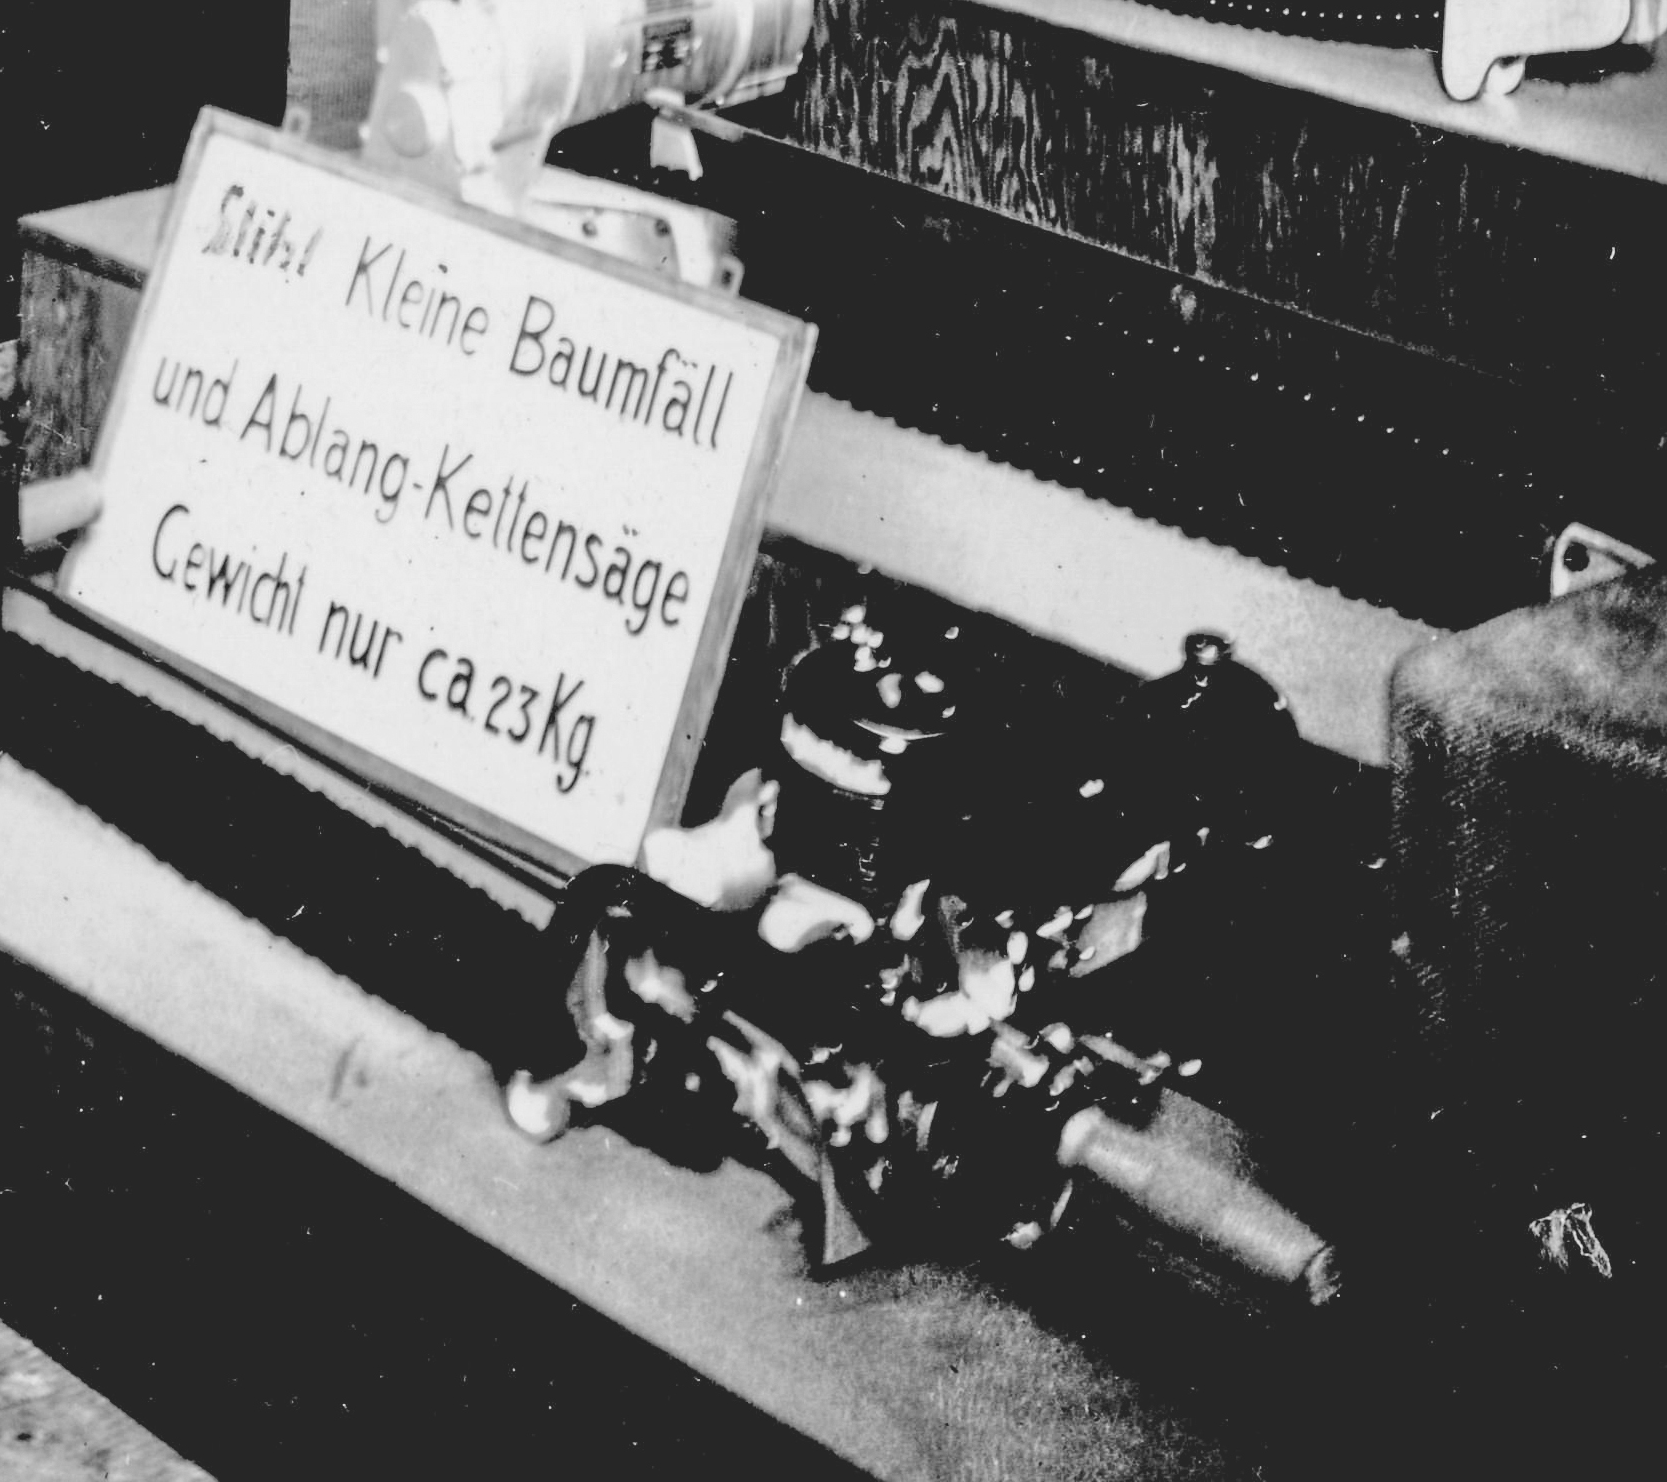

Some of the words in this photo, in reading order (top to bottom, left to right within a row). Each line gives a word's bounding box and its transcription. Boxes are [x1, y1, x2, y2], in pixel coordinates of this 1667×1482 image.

[201, 184, 325, 277] Stihl
[345, 236, 490, 356] Kleine
[509, 295, 734, 450] Baumfäll
[151, 503, 309, 637] Gewicht
[318, 600, 404, 679] nur
[152, 356, 239, 429] und
[240, 372, 690, 637] Ablang-Kettensäge
